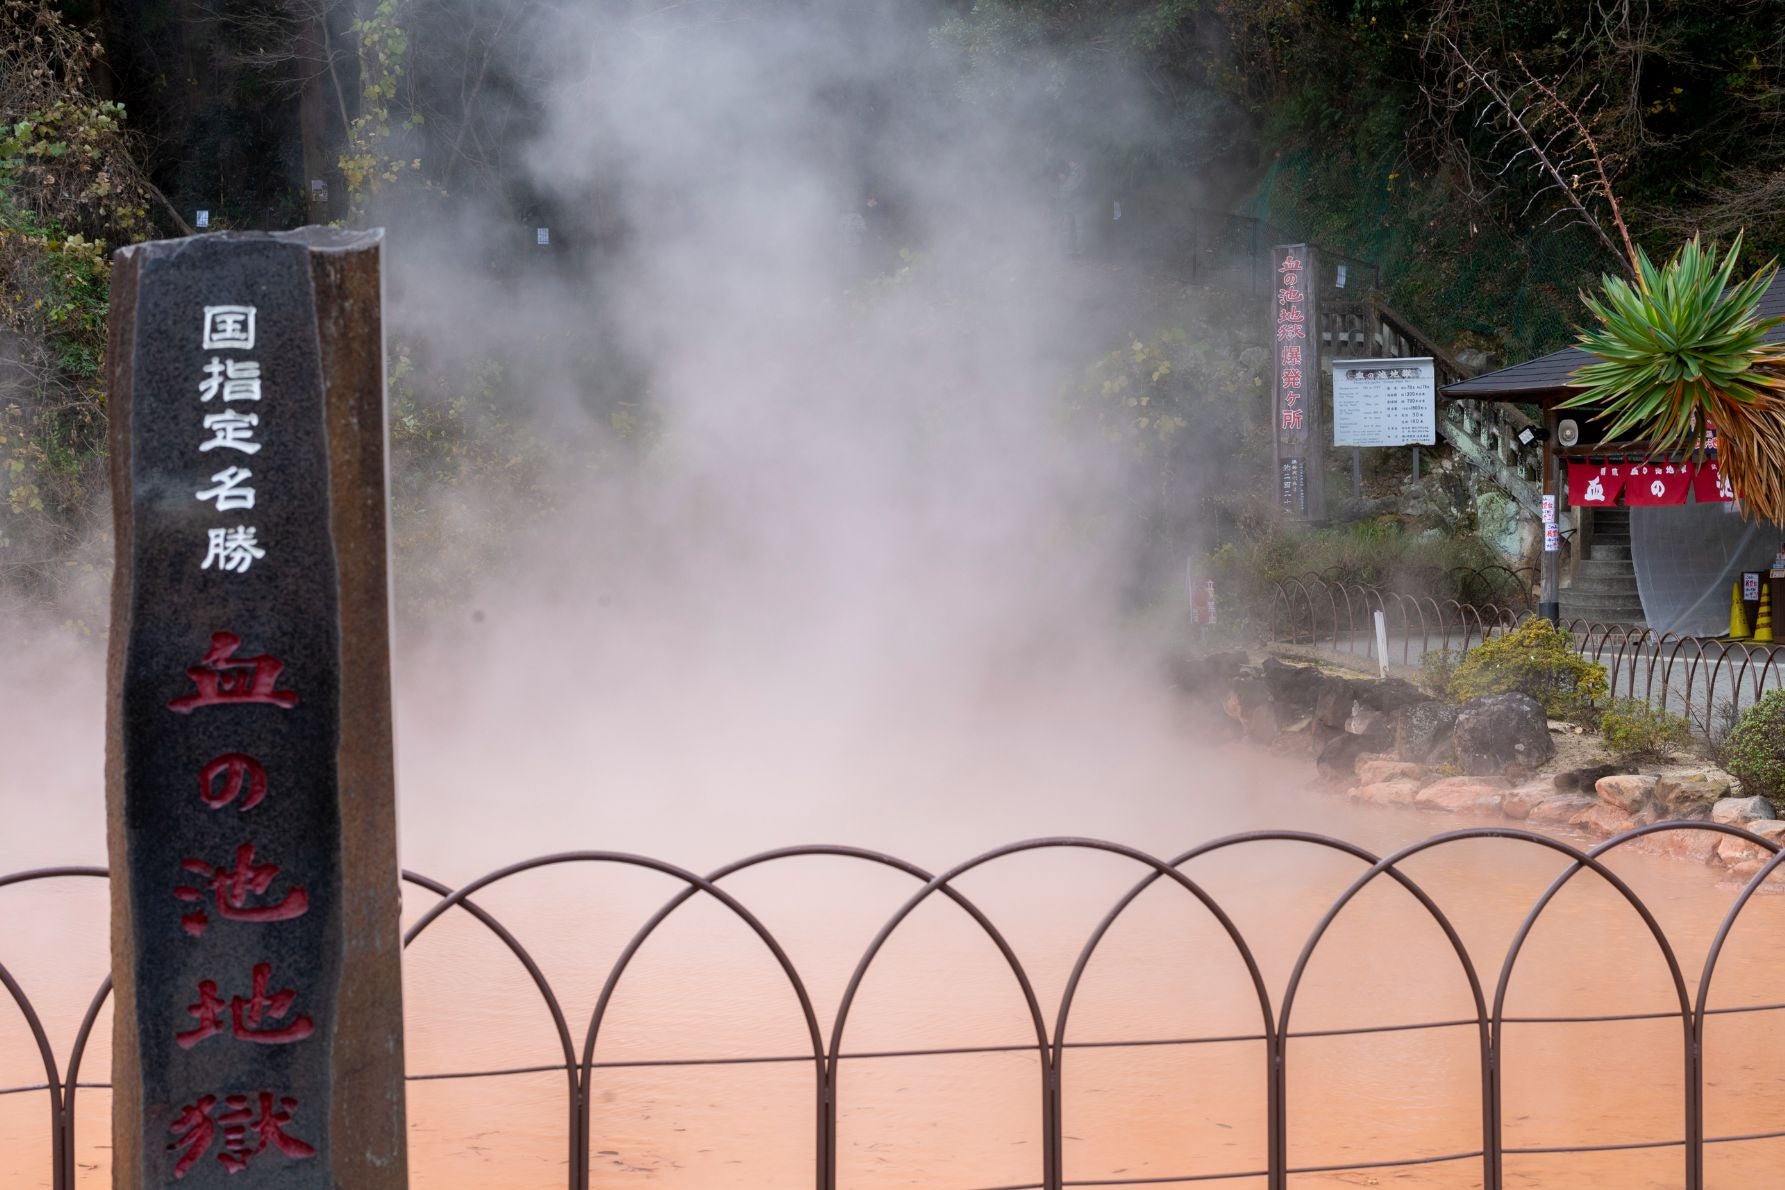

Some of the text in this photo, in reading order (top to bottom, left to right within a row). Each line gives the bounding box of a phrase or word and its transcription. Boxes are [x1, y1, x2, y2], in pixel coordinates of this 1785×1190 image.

[196, 305, 266, 573] 国指定名勝
[166, 630, 317, 1180] 血の池地獄
